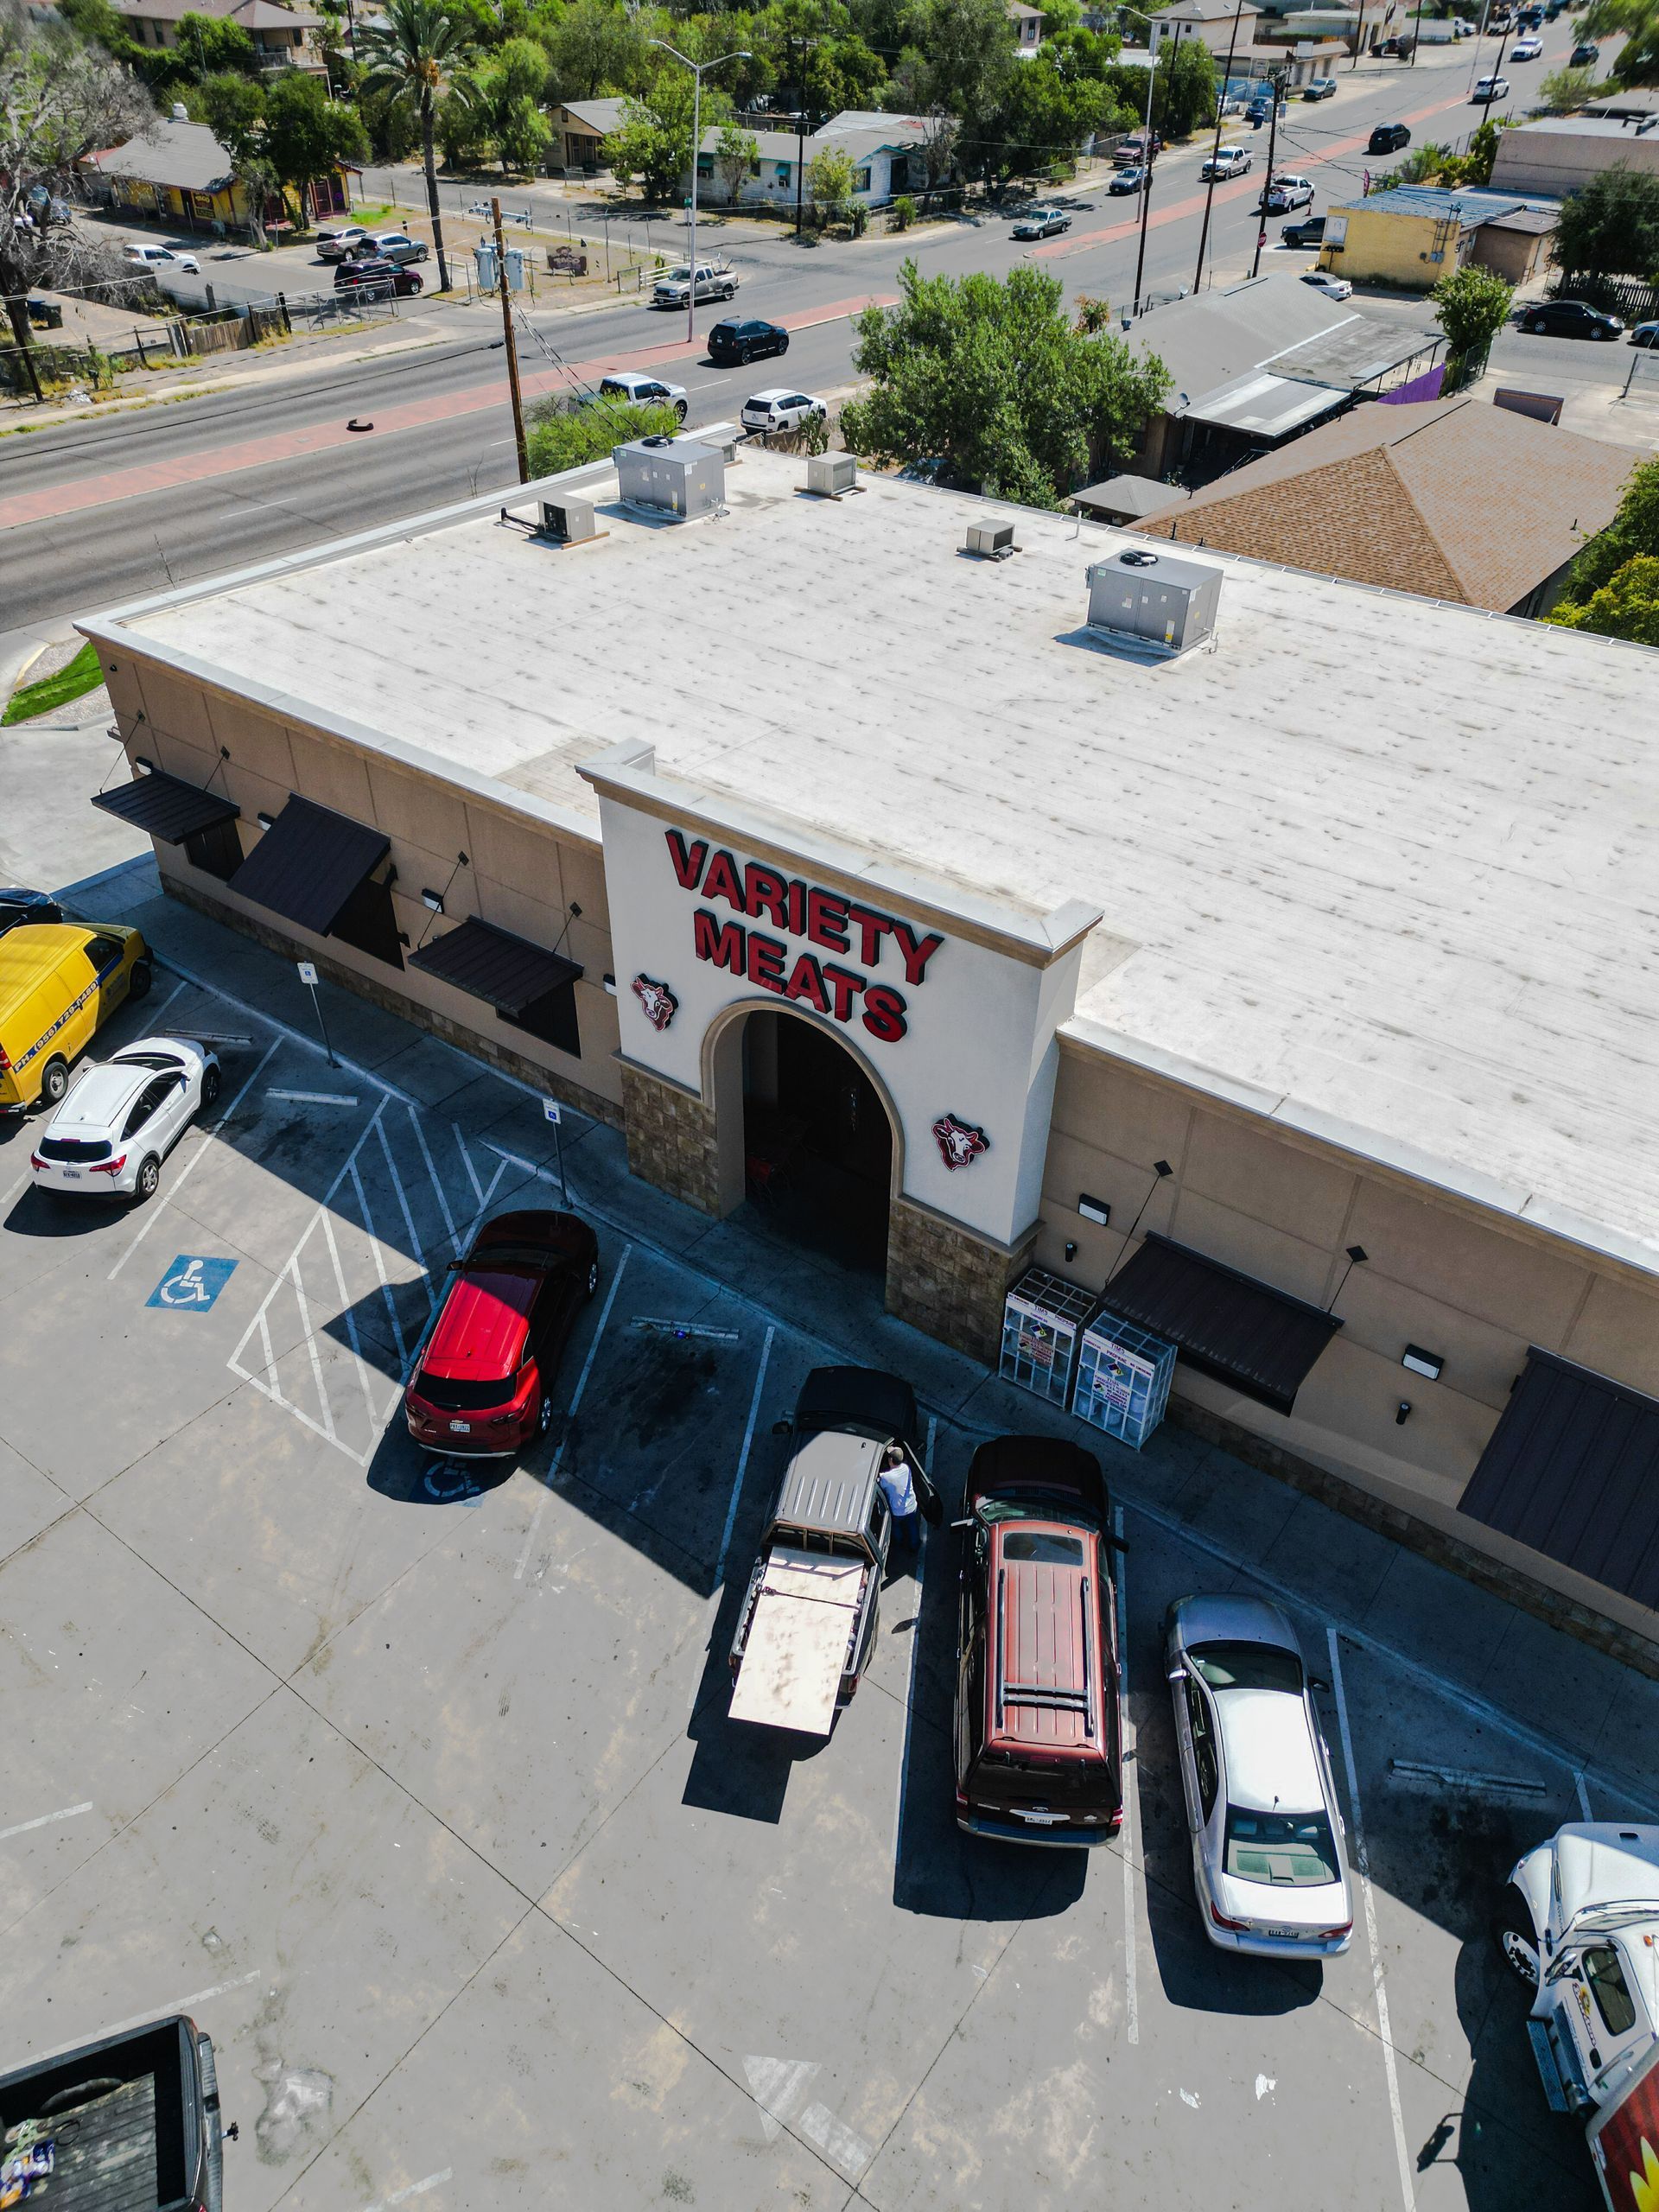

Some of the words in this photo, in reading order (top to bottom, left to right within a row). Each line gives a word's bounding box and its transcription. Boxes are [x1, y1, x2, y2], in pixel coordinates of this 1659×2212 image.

[664, 830, 944, 986] VARIETY
[693, 908, 908, 1043] MEATS
[35, 1025, 58, 1052] (956)
